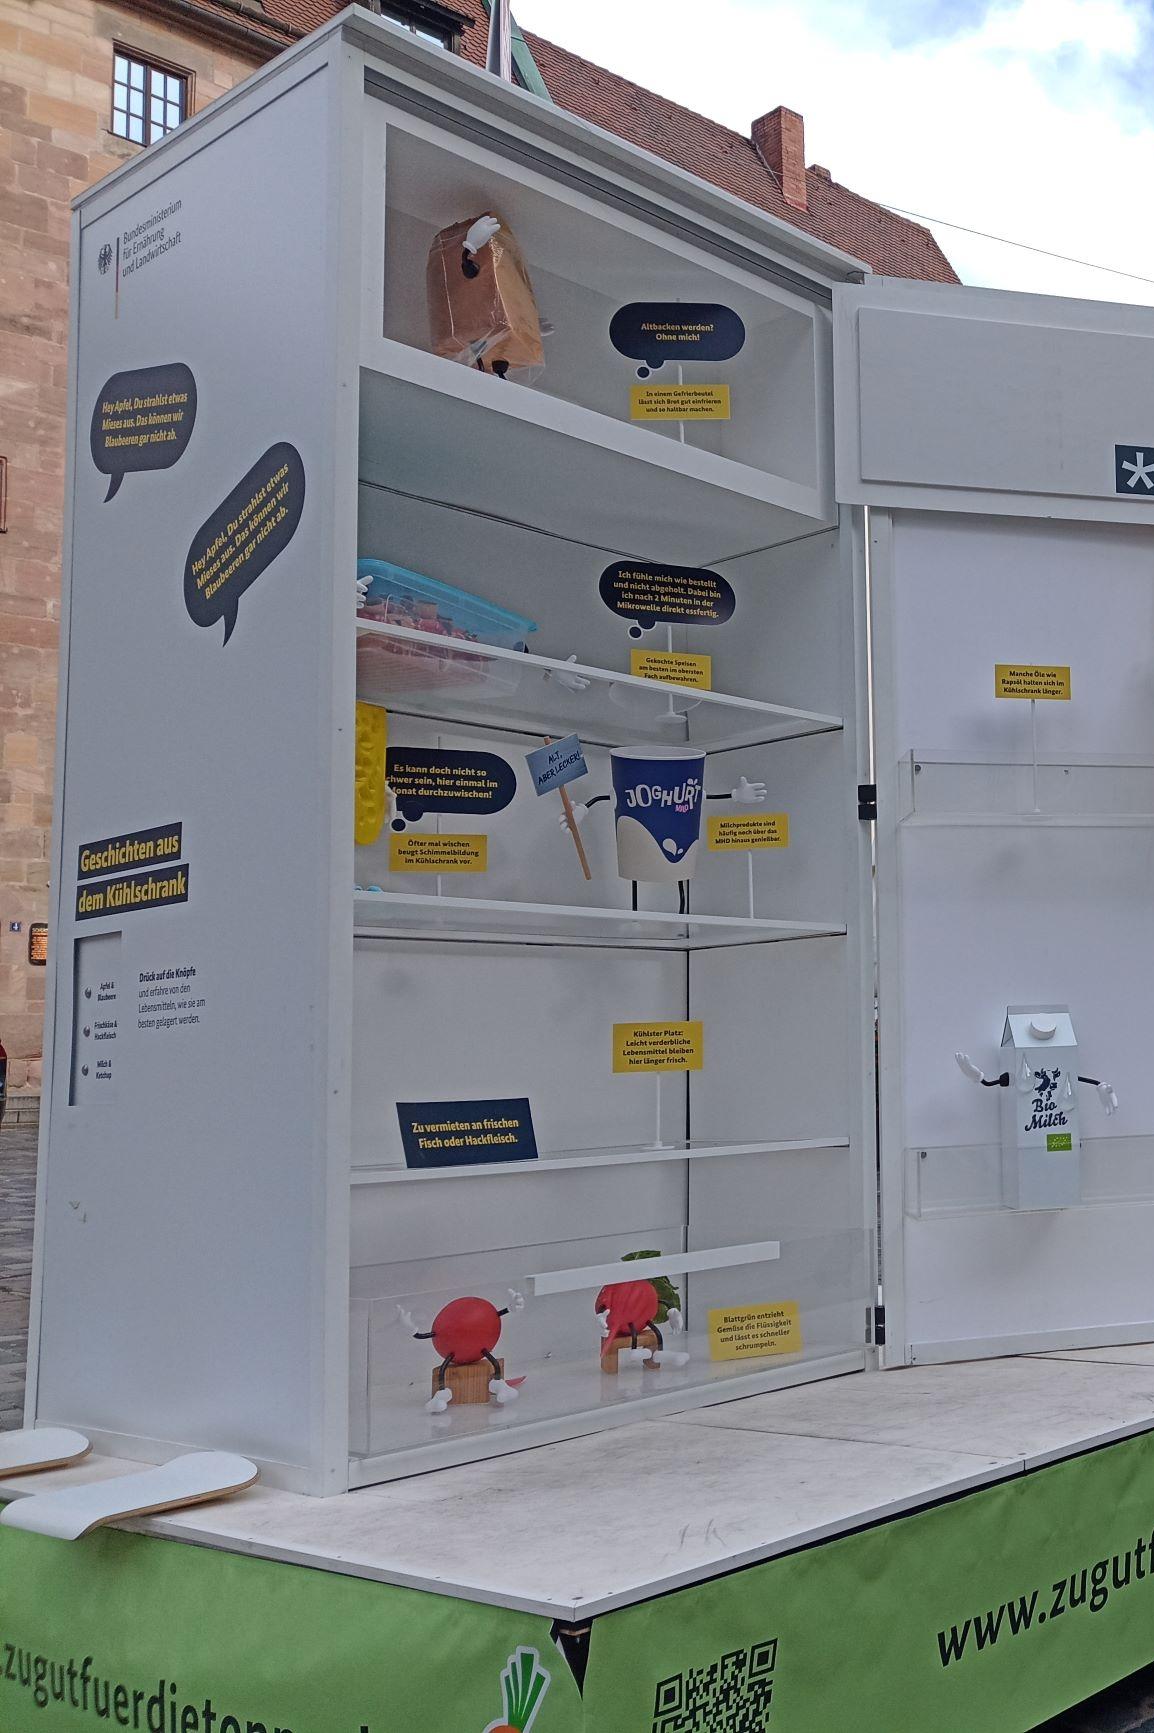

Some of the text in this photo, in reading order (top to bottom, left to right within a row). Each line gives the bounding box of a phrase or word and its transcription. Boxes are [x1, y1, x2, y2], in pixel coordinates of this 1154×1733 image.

[123, 199, 182, 245] Bundesministerium
[122, 227, 165, 261] für Ernährung
[122, 231, 181, 277] und Landwirtschaft
[641, 323, 680, 331] Altbacken
[102, 393, 188, 415] Hey Apfel, Du strahlst etwas
[102, 410, 184, 430] Mieses aus. Das können wir
[105, 428, 176, 448] Blaubeeren gar nicht ab.
[192, 464, 289, 575] Hey Apfel, Du strahlst etwas
[197, 482, 289, 589] Mieses aus. Das können wir
[205, 508, 289, 599] Blaubeeren gar nicht ab.
[633, 573, 652, 581] fühle
[655, 574, 672, 583] mich
[689, 578, 716, 588] bestellt
[614, 581, 628, 589] und
[651, 584, 686, 595] abgeholt.
[688, 588, 708, 597] Dabei
[622, 591, 633, 599] ich
[635, 592, 653, 600] nach
[661, 595, 692, 604] Minuten
[702, 599, 713, 607] der
[617, 602, 660, 611] Mikrowelle
[686, 609, 719, 618] essfertig.
[549, 751, 562, 764] ALT,
[406, 765, 427, 773] kann
[430, 766, 450, 774] doch
[453, 768, 475, 776] nicht
[538, 750, 580, 785] ABER LECKER!
[386, 775, 414, 783] chwer
[415, 777, 435, 785] sein,
[456, 779, 485, 787] einmal
[487, 780, 498, 788] im
[419, 788, 492, 798] durchzuwischen!
[625, 783, 701, 809] JOGHURT
[81, 836, 178, 872] Geschichten aus
[79, 871, 185, 912] dem Kühlschrank
[139, 971, 155, 982] Drück
[156, 969, 166, 981] auf
[176, 966, 195, 979] Knöpfe
[139, 984, 190, 998] und erfahre von den
[139, 999, 205, 1013] Lebensmitteln, wie sie am
[138, 1015, 199, 1029] besten gelagert werden.
[1032, 1099, 1057, 1112] Bio
[412, 1118, 518, 1133] Zu vermieten an frischen
[1025, 1112, 1068, 1131] Milch
[419, 1133, 518, 1148] Fisch oder Hackfleisch.
[724, 1311, 784, 1323] Blattgrün entzieht
[717, 1324, 743, 1333] Gemüse
[757, 1320, 791, 1329] Flüssigkeit
[760, 1330, 790, 1338] schneller
[736, 1340, 776, 1351] schrumpeln.
